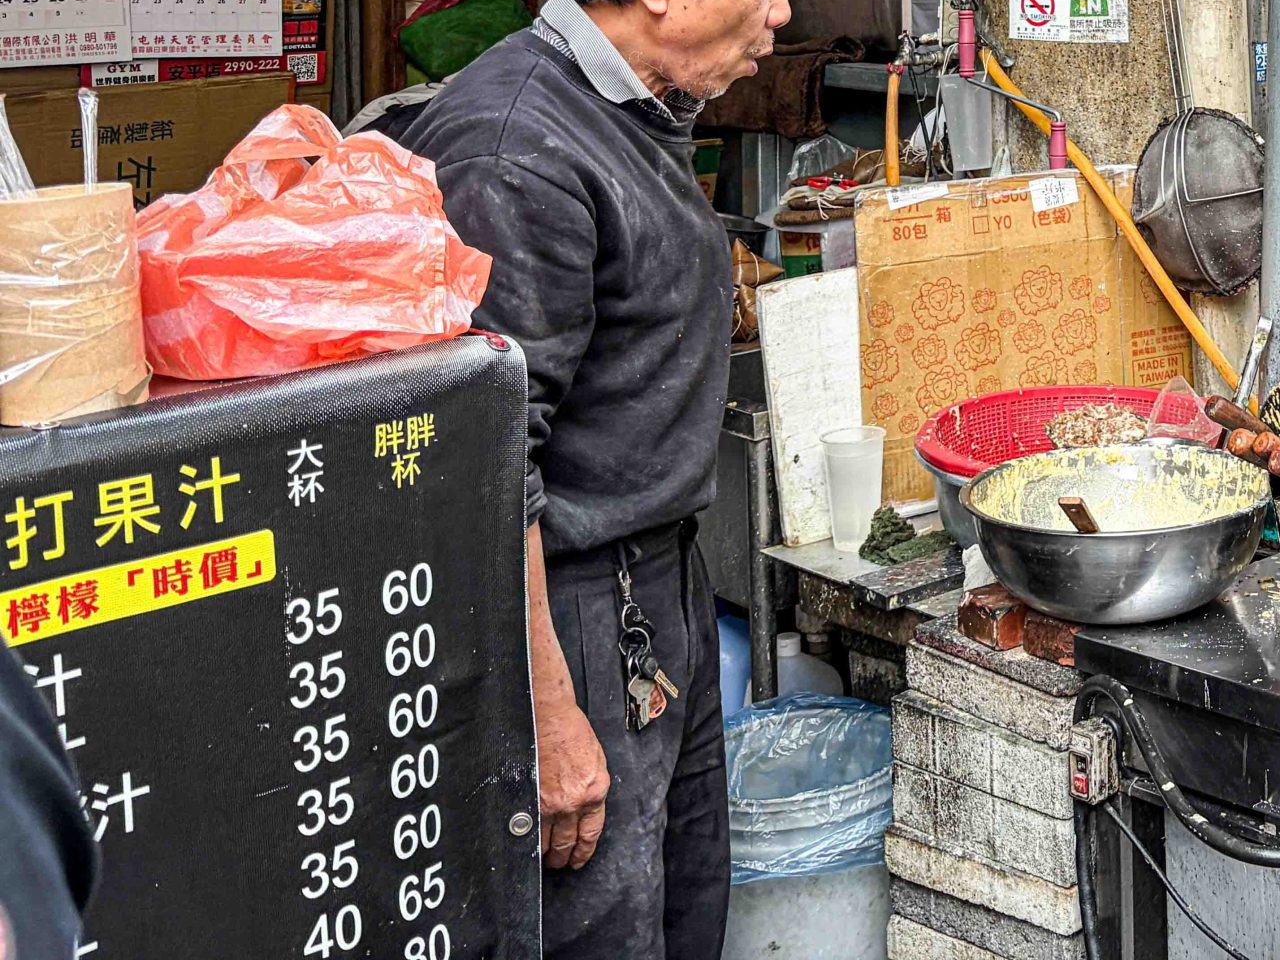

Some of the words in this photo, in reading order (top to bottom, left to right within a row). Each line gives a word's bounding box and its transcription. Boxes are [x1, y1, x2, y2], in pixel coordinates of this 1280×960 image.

[131, 34, 272, 45] 屯拱天宮管理委員會
[107, 63, 142, 73] GYM
[168, 63, 222, 80] 安平店
[225, 59, 280, 72] 2990-222
[893, 224, 928, 241] 80包
[936, 207, 951, 223] 箱
[1138, 358, 1166, 372] MADE
[1168, 356, 1178, 367] IN
[1140, 369, 1178, 384] TAIWAN
[374, 412, 436, 457] 胖胖
[287, 440, 325, 508] 大杯
[391, 453, 422, 489] 杯
[4, 456, 241, 570] 打果汁
[286, 588, 343, 645] 35
[382, 562, 434, 615] 60
[289, 651, 347, 710] 35
[384, 623, 436, 677] 60
[293, 714, 350, 773] 35
[388, 684, 439, 739] 60
[297, 777, 355, 836] 35
[390, 744, 440, 800] 60
[301, 840, 359, 899] 35
[393, 804, 442, 860] 60
[303, 904, 362, 959] 40
[398, 862, 446, 922] 65
